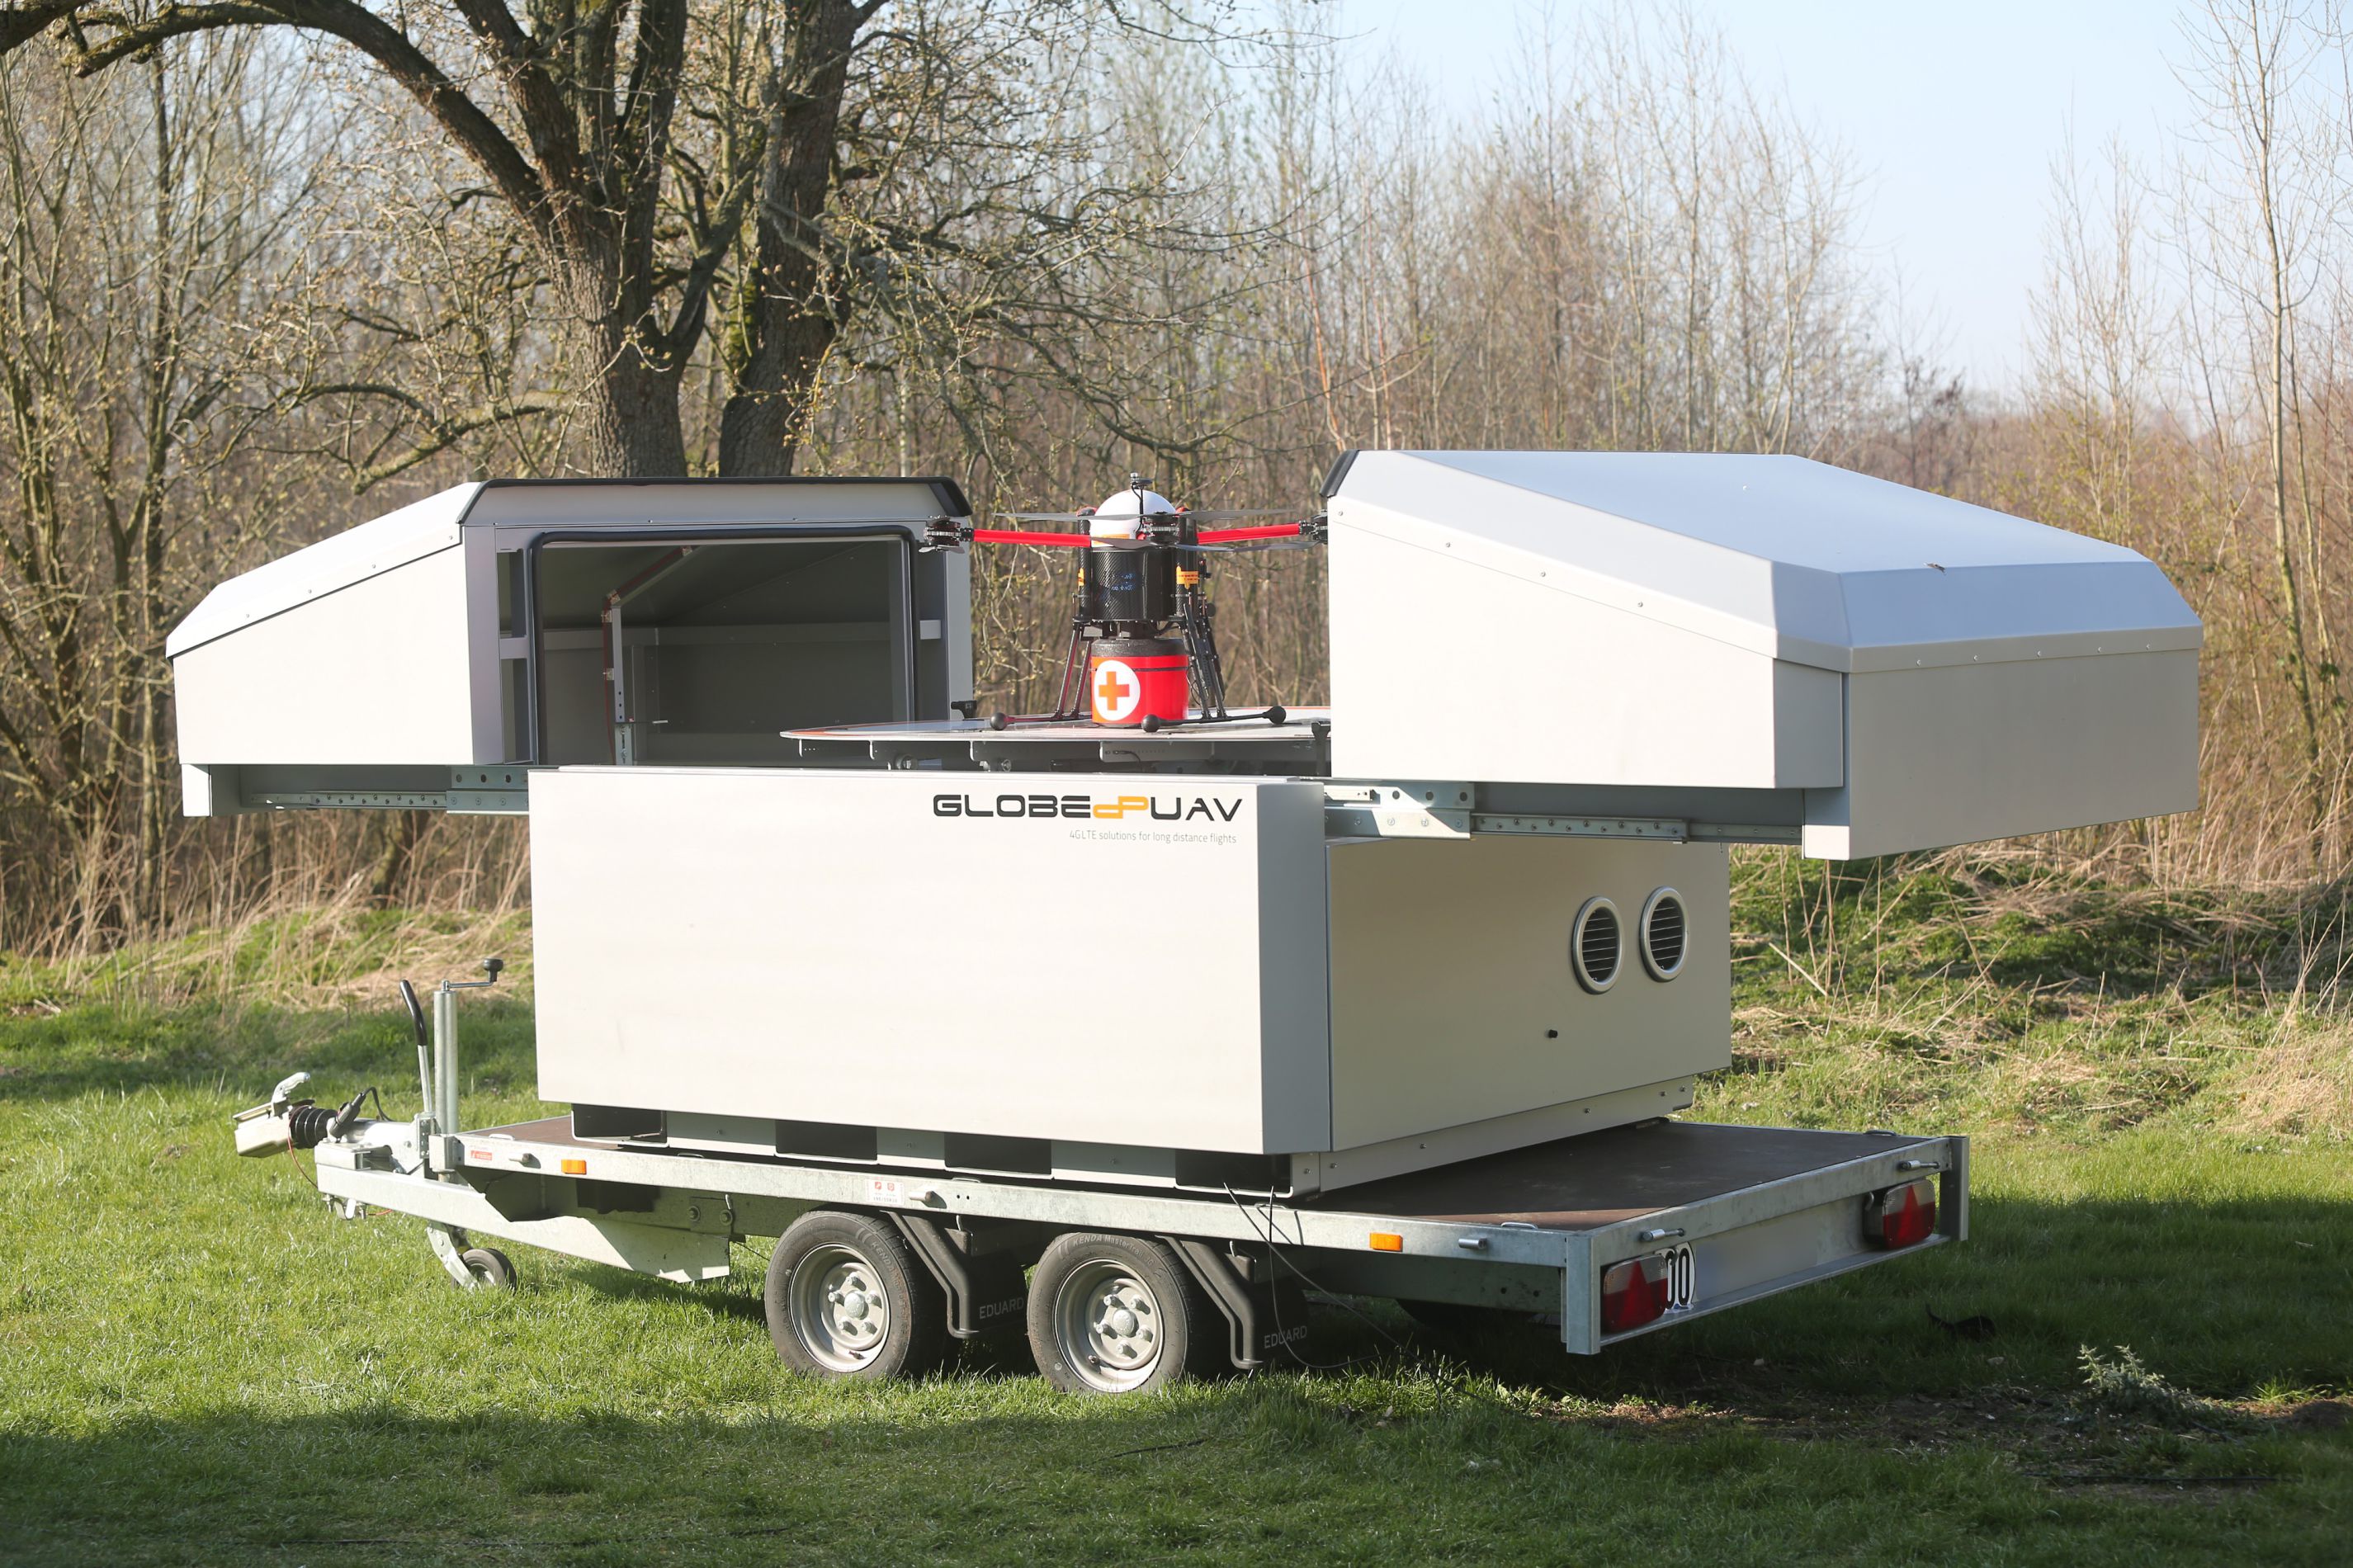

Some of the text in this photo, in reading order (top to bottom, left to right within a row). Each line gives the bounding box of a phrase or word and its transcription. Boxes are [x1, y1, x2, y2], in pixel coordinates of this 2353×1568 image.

[1099, 829, 1136, 841] solutions
[1139, 831, 1151, 841] for
[1153, 831, 1171, 843] long
[1174, 832, 1208, 843] distance
[1210, 833, 1236, 845] flights
[1073, 1234, 1103, 1247] KENDA
[871, 1240, 897, 1273] KENDA
[979, 1296, 1024, 1320] EDUARD
[1264, 1325, 1307, 1349] EDUARD
